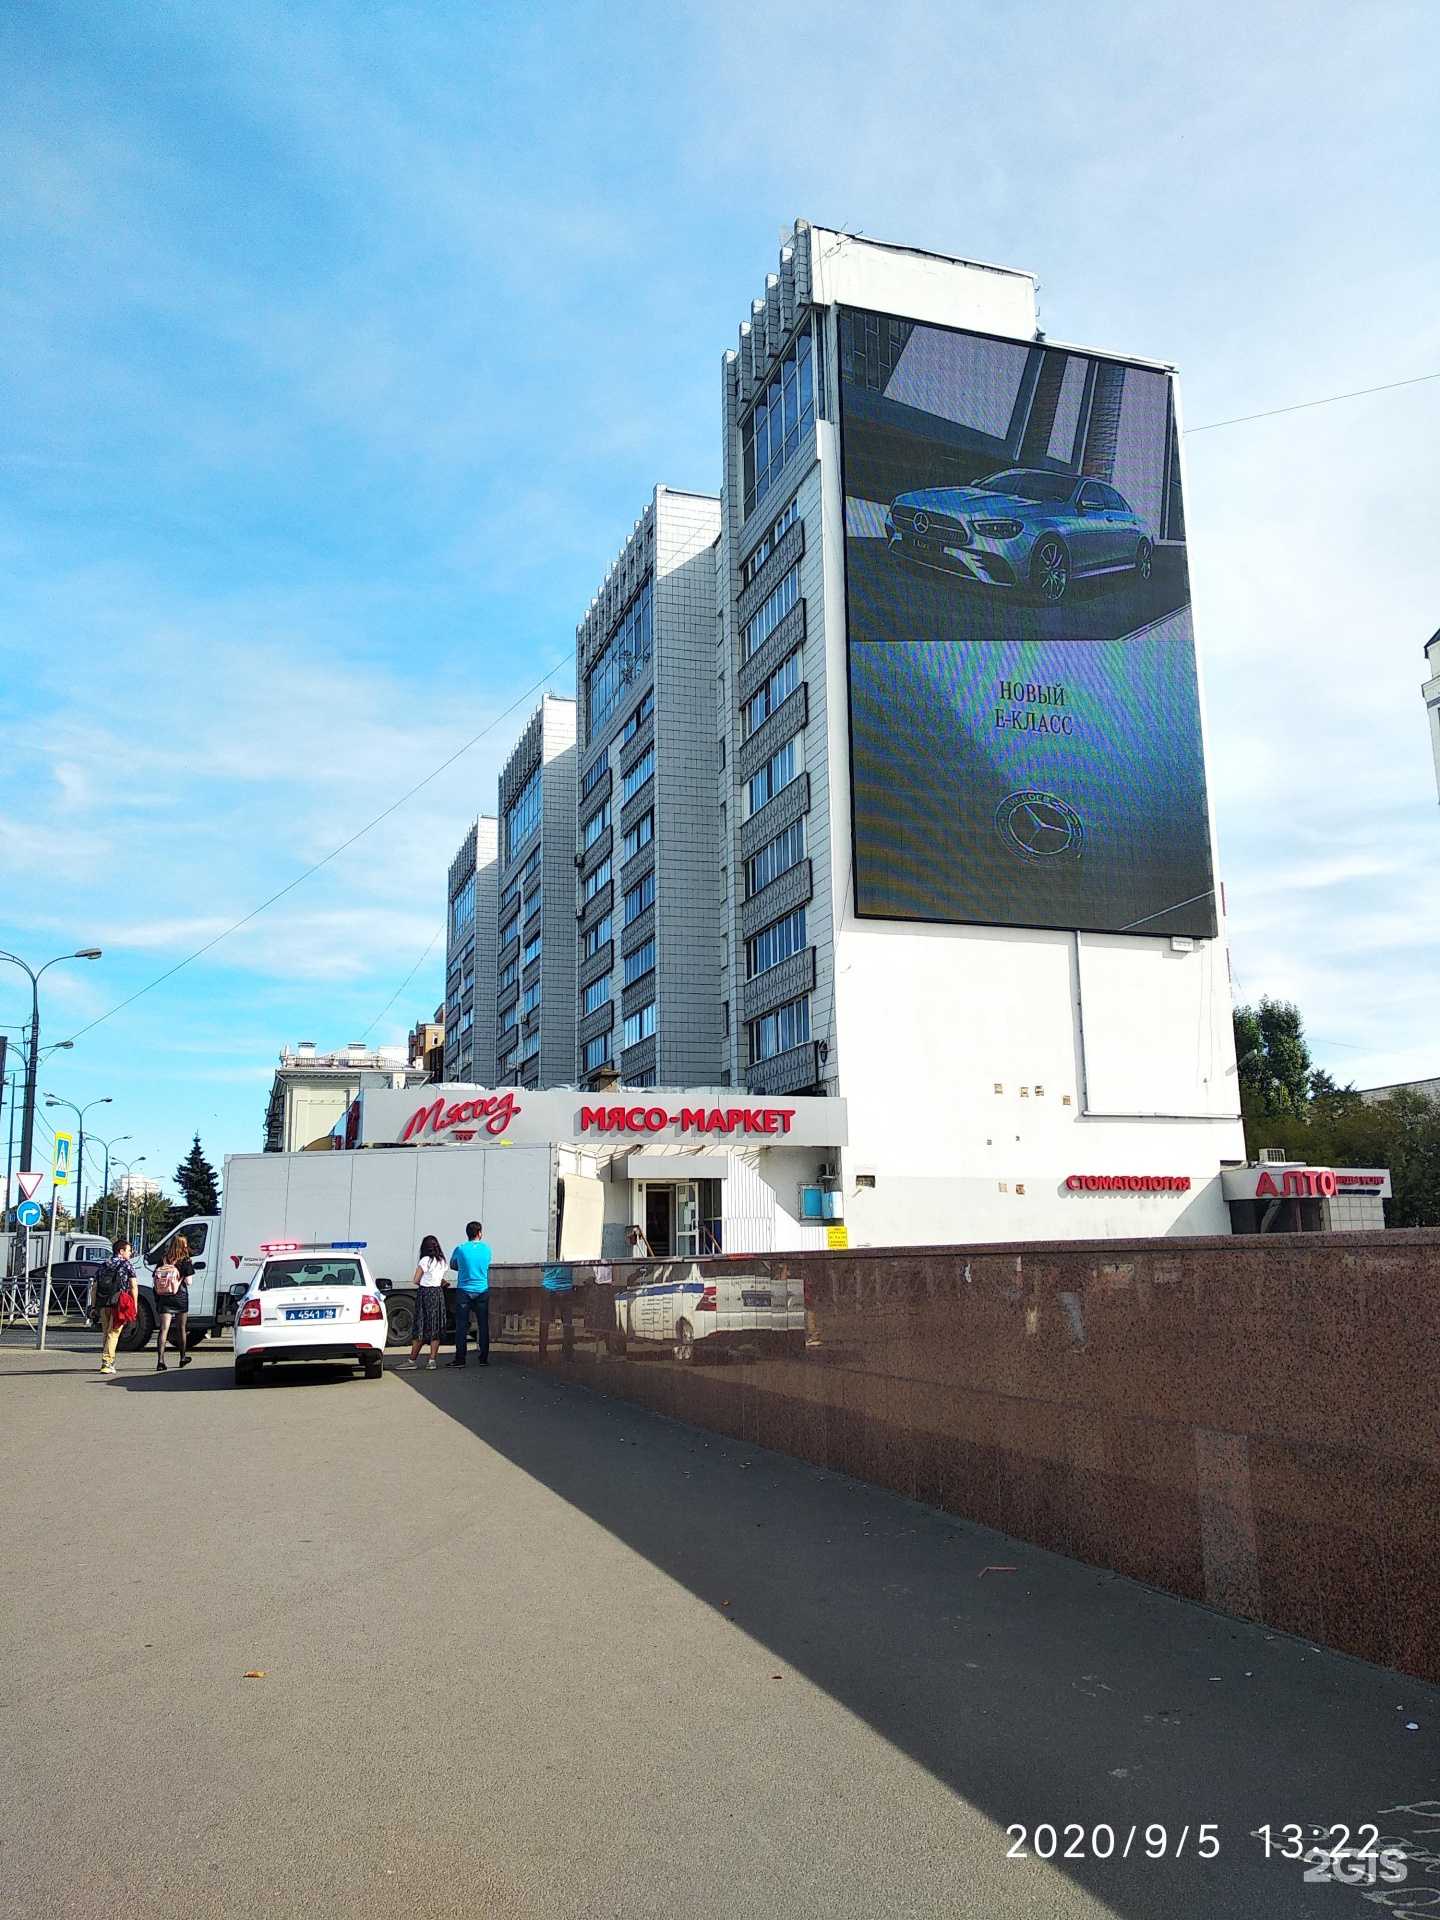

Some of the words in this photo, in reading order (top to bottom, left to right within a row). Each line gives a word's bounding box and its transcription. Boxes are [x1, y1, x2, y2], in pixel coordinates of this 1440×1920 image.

[1000, 680, 1065, 706] НОВЫЙ
[994, 708, 1073, 736] Е-КЛАСС
[580, 1106, 796, 1133] МЯСО-МАРКЕТ
[1066, 1175, 1191, 1191] СТОМАТОЛОГИЯ
